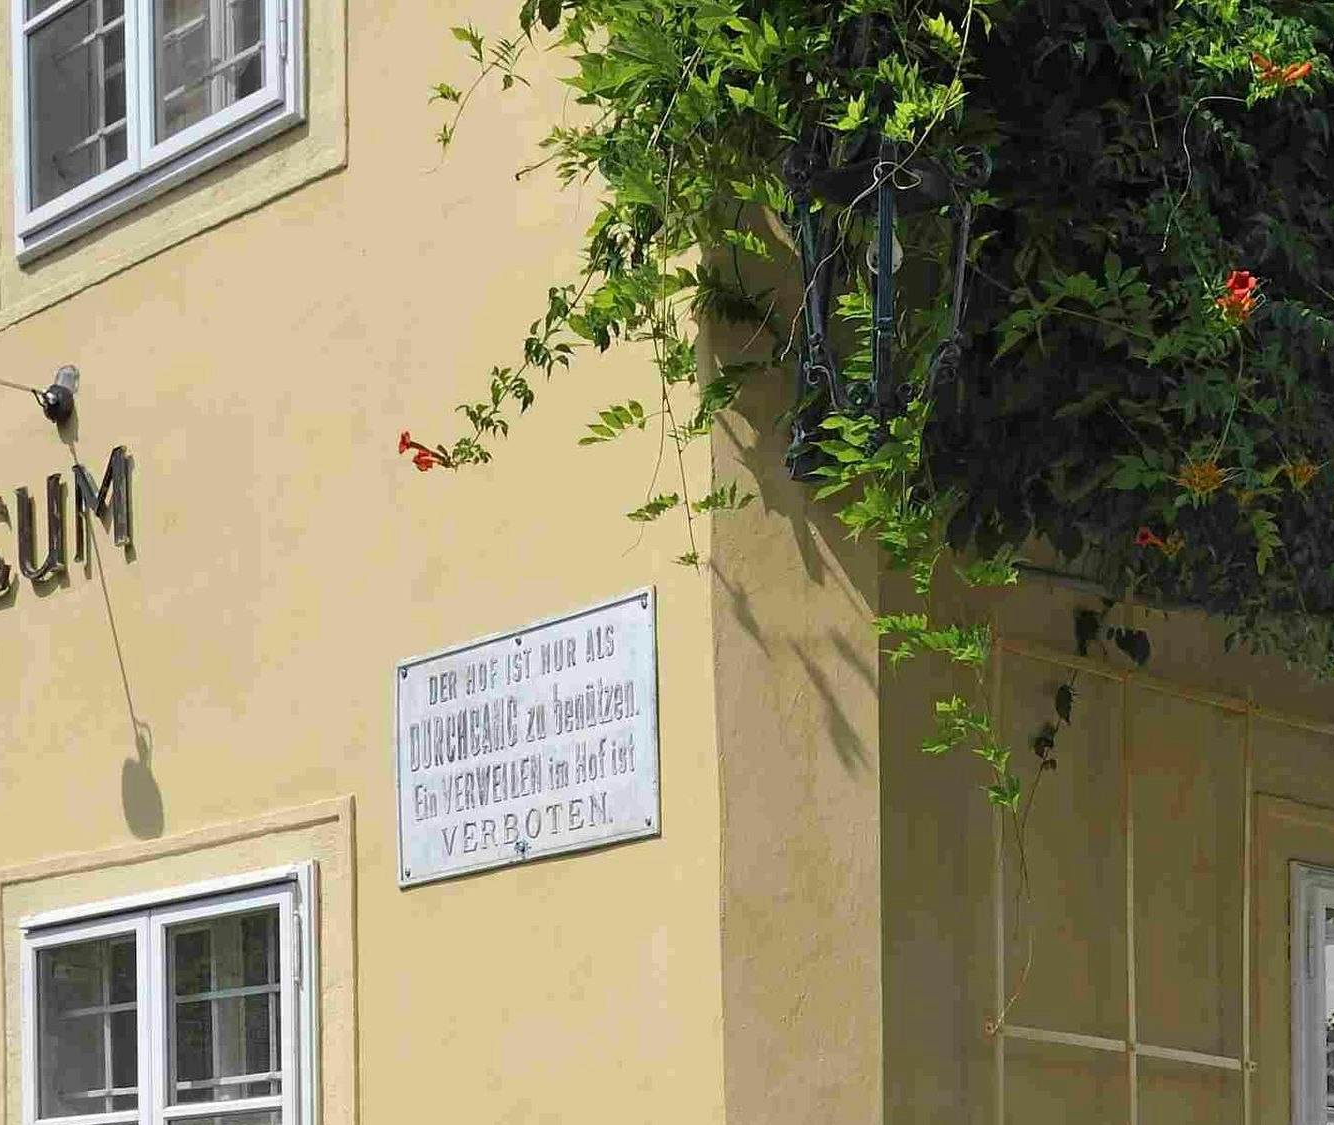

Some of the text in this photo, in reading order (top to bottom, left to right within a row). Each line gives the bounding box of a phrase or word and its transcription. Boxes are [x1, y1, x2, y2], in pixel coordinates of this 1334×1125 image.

[428, 670, 457, 705] DER
[506, 647, 533, 686] IST
[586, 624, 615, 662] ALS
[414, 733, 636, 820] Ein VERWEILEN im Hof ist
[442, 791, 614, 857] VERBOTEN.
